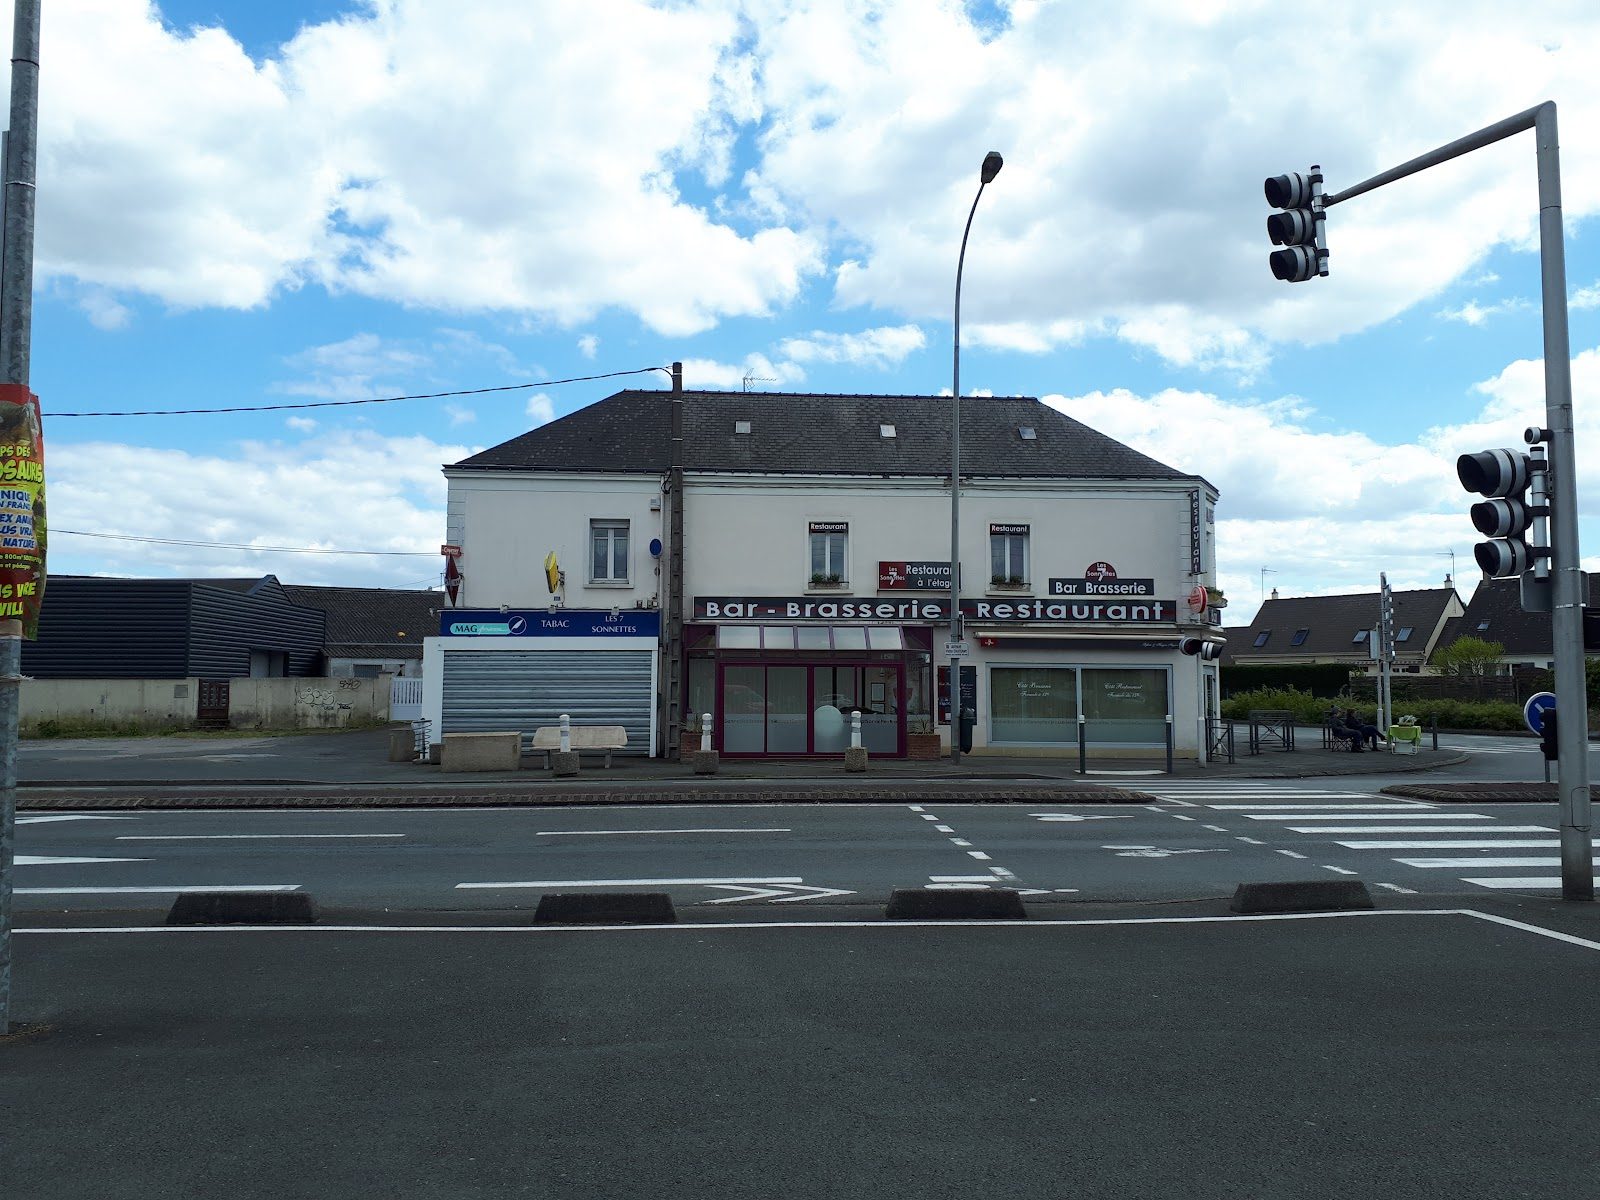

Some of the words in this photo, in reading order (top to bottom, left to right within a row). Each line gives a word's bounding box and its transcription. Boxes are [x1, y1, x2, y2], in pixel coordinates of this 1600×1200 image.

[1192, 491, 1200, 573] Restaurant
[905, 564, 952, 575] Restaura
[888, 572, 898, 586] 7
[917, 577, 923, 587] à
[1055, 581, 1078, 594] Bar
[1085, 582, 1147, 594] Brasserie
[706, 601, 759, 618] Bar
[786, 599, 942, 618] Brasserie
[977, 600, 1164, 620] Restaurant
[454, 625, 478, 633] MAG
[541, 619, 570, 628] TABAC
[591, 625, 637, 633] SONNETTES
